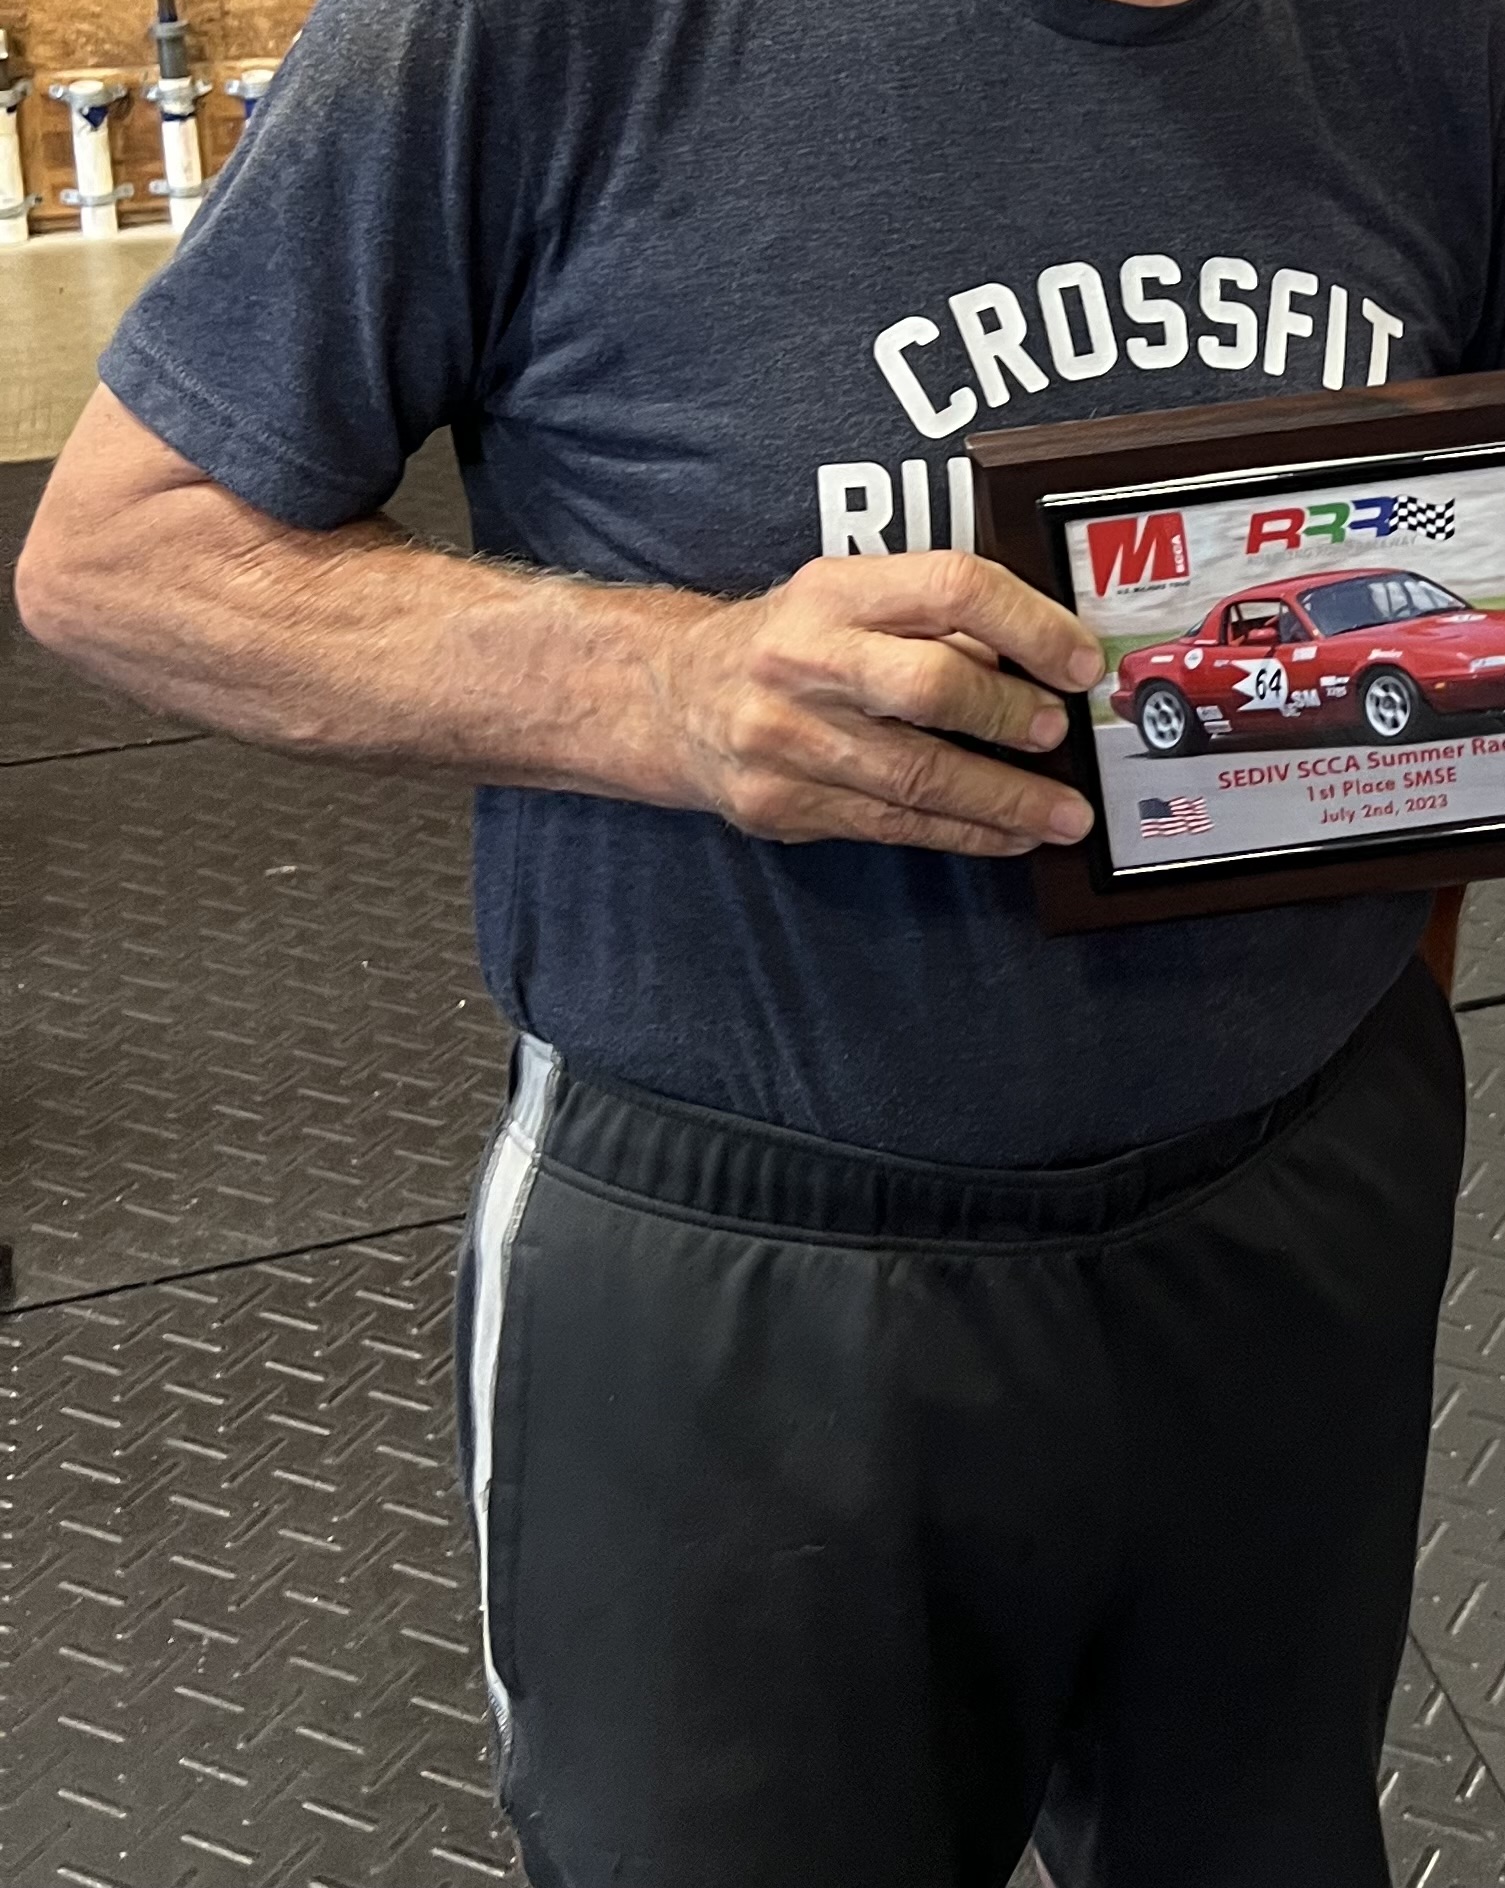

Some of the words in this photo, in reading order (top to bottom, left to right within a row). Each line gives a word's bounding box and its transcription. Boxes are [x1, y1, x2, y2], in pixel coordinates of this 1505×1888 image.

[874, 254, 1404, 439] CROSSFIT
[1255, 668, 1281, 701] 64
[1218, 762, 1290, 790] SEDIV
[1297, 754, 1360, 779] SCCA
[1367, 743, 1464, 770] Summer
[1306, 784, 1336, 802] 1st
[1343, 778, 1396, 797] Place
[1403, 766, 1458, 788] SMSE
[1321, 807, 1356, 825] July
[1406, 794, 1448, 813] 2023
